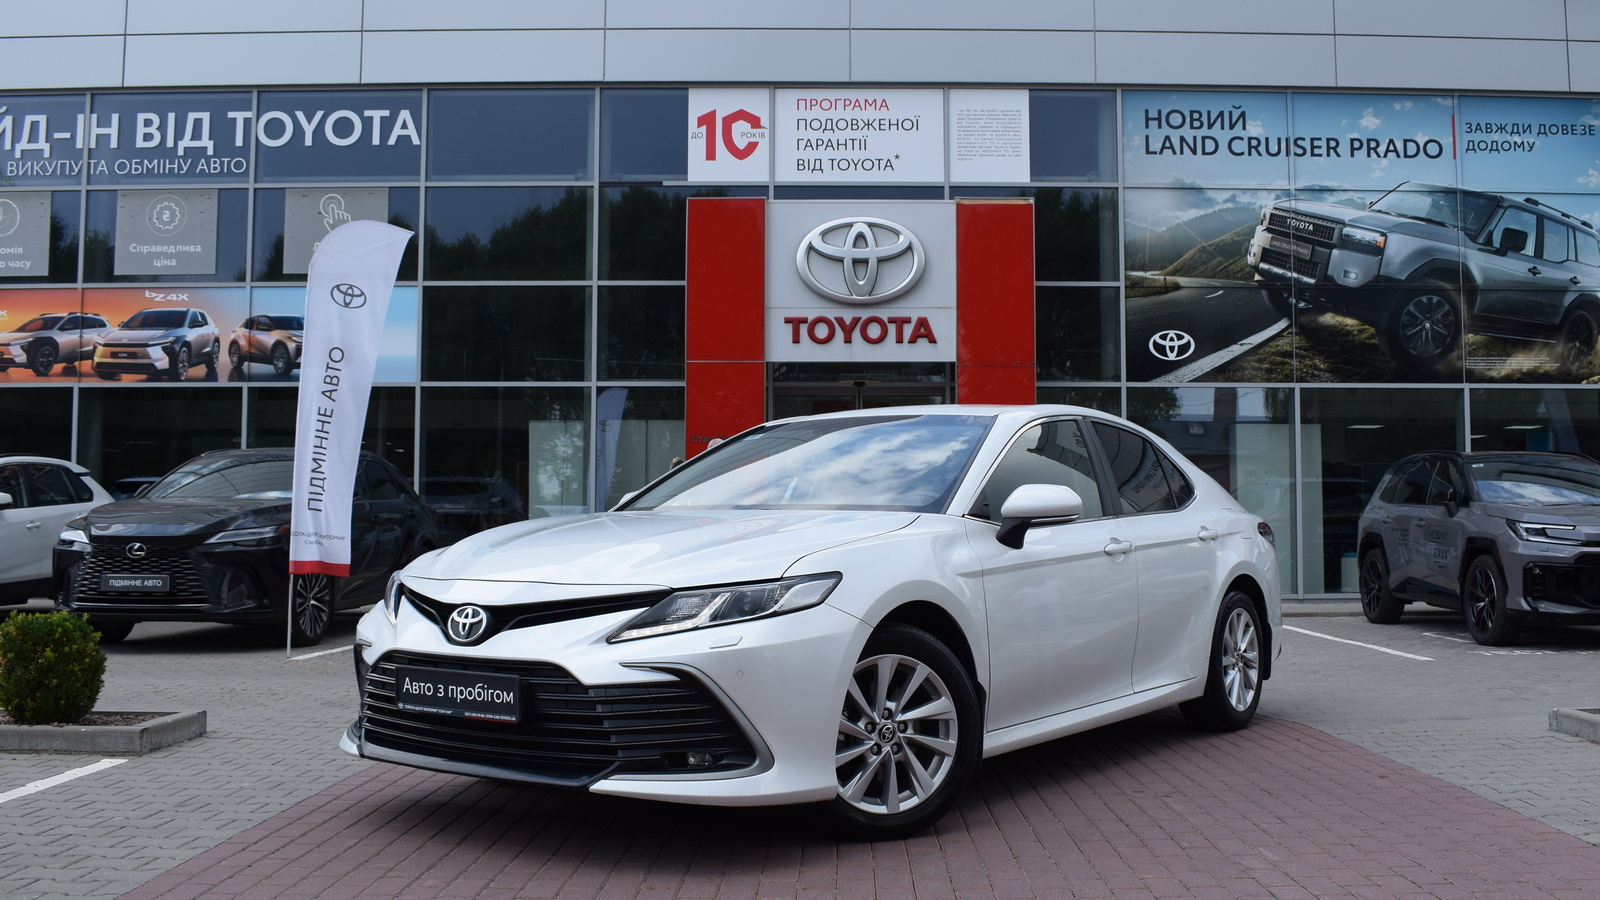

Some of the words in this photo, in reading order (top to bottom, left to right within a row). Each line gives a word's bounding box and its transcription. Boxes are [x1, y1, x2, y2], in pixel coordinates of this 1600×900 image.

[796, 98, 890, 112] ПРОГРАМА
[796, 115, 921, 134] ПОДОВЖЕНОЇ
[1144, 104, 1247, 131] НОВИЙ
[135, 112, 214, 156] ВІД
[227, 109, 422, 148] TOYOTA
[691, 131, 704, 140] ДО
[740, 131, 766, 139] РОКІВ
[1464, 121, 1533, 136] ЗАВЖДИ
[1536, 123, 1597, 137] ДОВЕЗЕ
[796, 135, 869, 151] ГАРАНТІЇ
[1144, 134, 1220, 156] LAND
[1227, 136, 1342, 158] CRUISER
[1349, 137, 1444, 160] PRADO
[1465, 139, 1537, 154] ДОДОМУ
[7, 160, 83, 176] ВИКУПУ
[88, 159, 109, 175] ТА
[114, 158, 193, 175] ОБМІНУ
[196, 157, 247, 174] АВТО
[796, 158, 824, 174] ВІД
[130, 244, 201, 253] Справедлива
[8, 261, 32, 270] часу
[153, 258, 177, 266] ціна
[784, 316, 937, 344] TOYOTA
[307, 406, 335, 512] ПІДМІННЕ
[321, 347, 345, 403] АВТО
[109, 579, 142, 587] ПІДМІННЕ
[403, 677, 434, 696] Авто
[437, 685, 444, 697] з
[448, 683, 514, 704] пробігом
